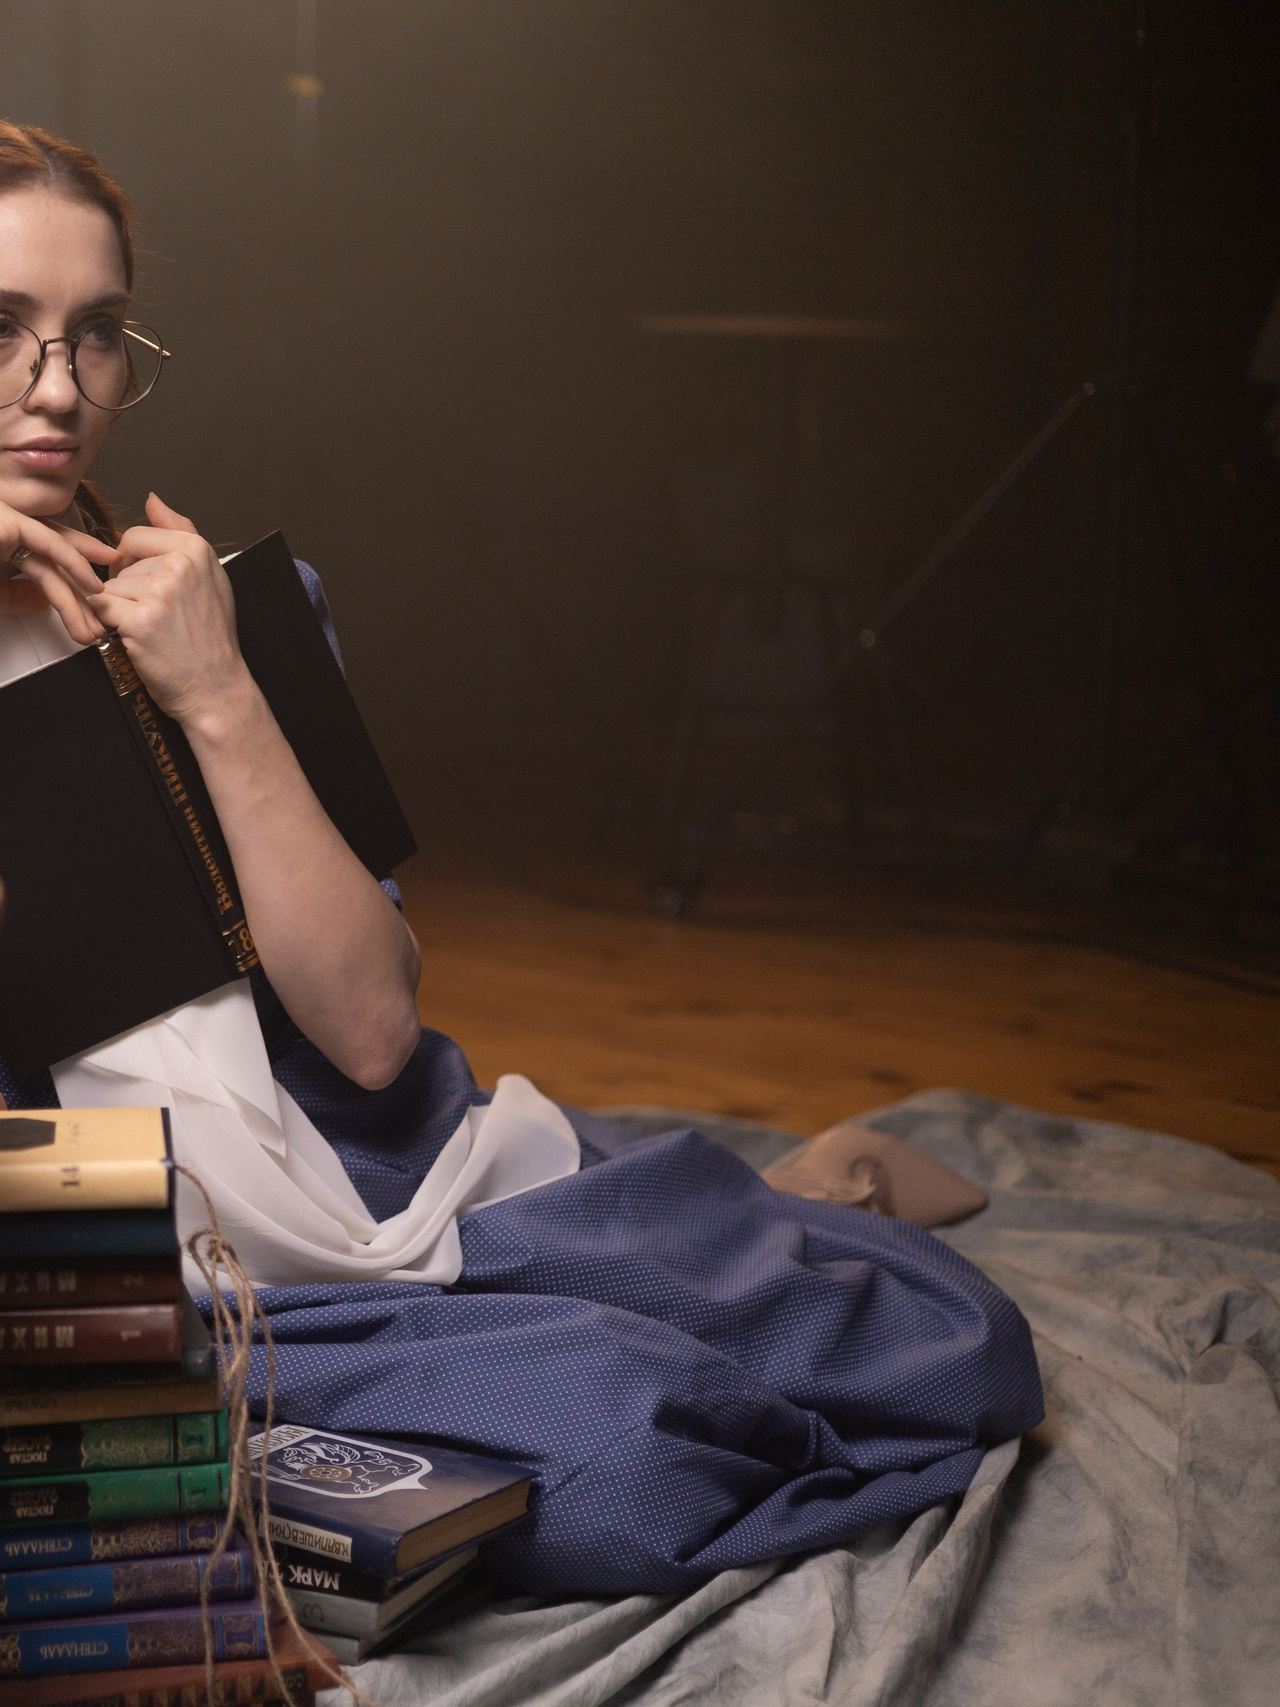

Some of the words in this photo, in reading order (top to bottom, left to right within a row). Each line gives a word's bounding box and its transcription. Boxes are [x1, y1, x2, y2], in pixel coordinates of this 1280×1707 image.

[133, 693, 188, 806] ПИКУЛЬ
[184, 805, 234, 915] Валентин
[228, 926, 256, 959] 18
[121, 1329, 141, 1341] 1
[187, 1434, 204, 1445] 2
[5, 1537, 73, 1556] СТЕНДАЛЬ
[288, 1564, 342, 1590] МАРК
[40, 1640, 108, 1659] СТЕНДАЛЬ
